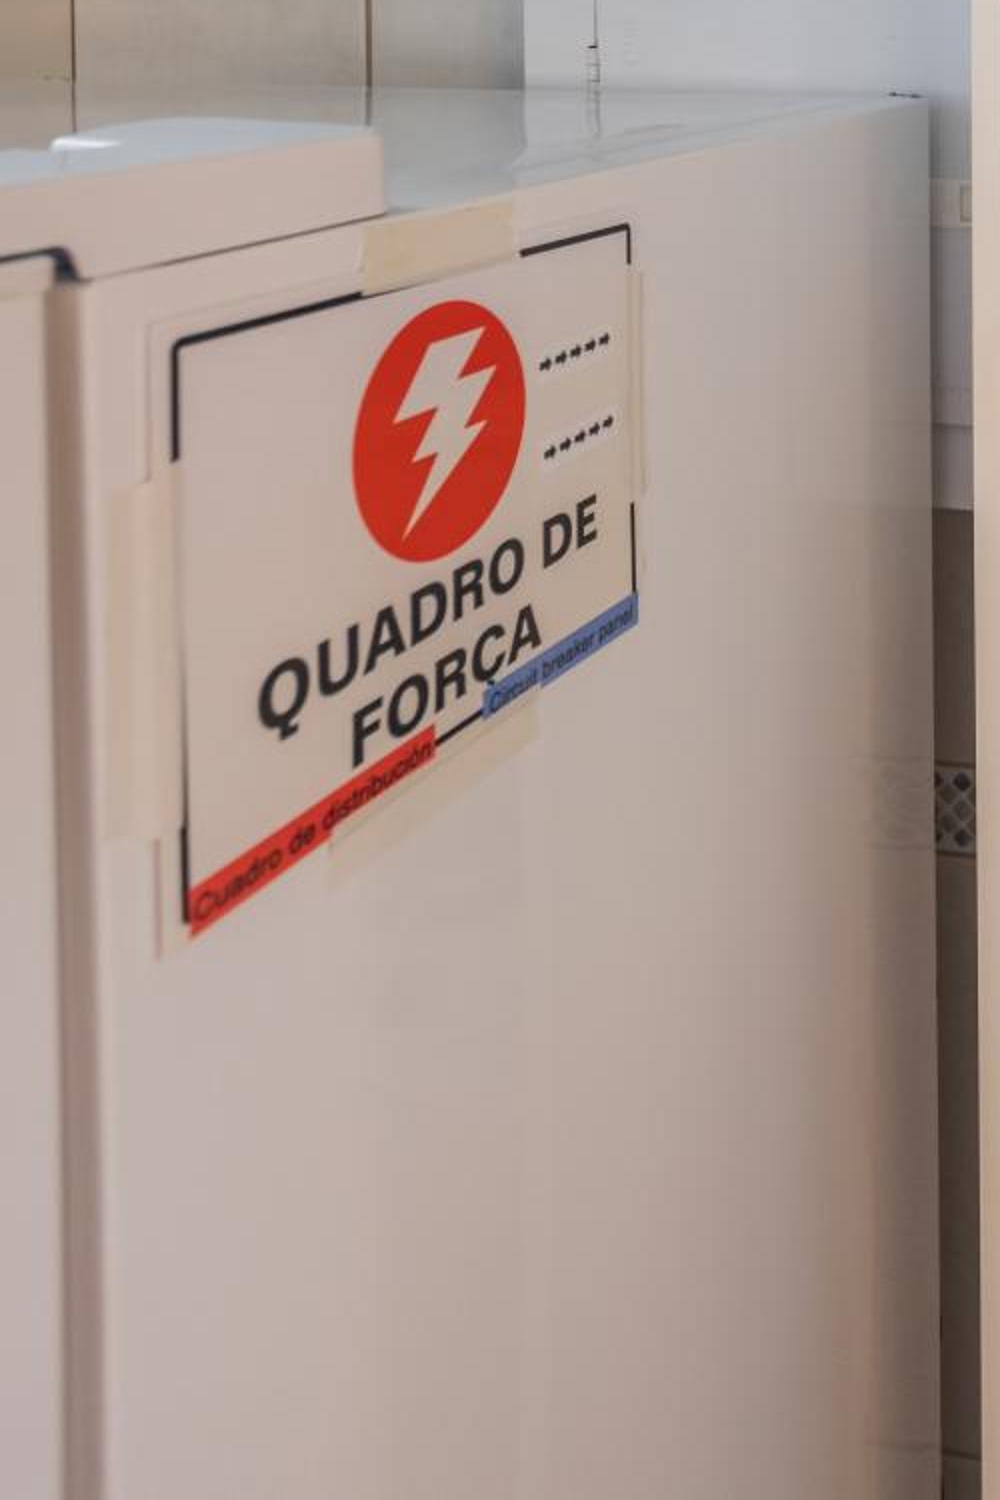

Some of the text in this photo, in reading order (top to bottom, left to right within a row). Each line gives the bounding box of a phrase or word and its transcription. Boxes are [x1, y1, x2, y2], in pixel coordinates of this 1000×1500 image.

[257, 493, 597, 742] QUADRO DE
[352, 603, 542, 769] FORÇA
[489, 601, 634, 714] Circuit breaker panel
[194, 742, 434, 922] Cuadro de distribución
